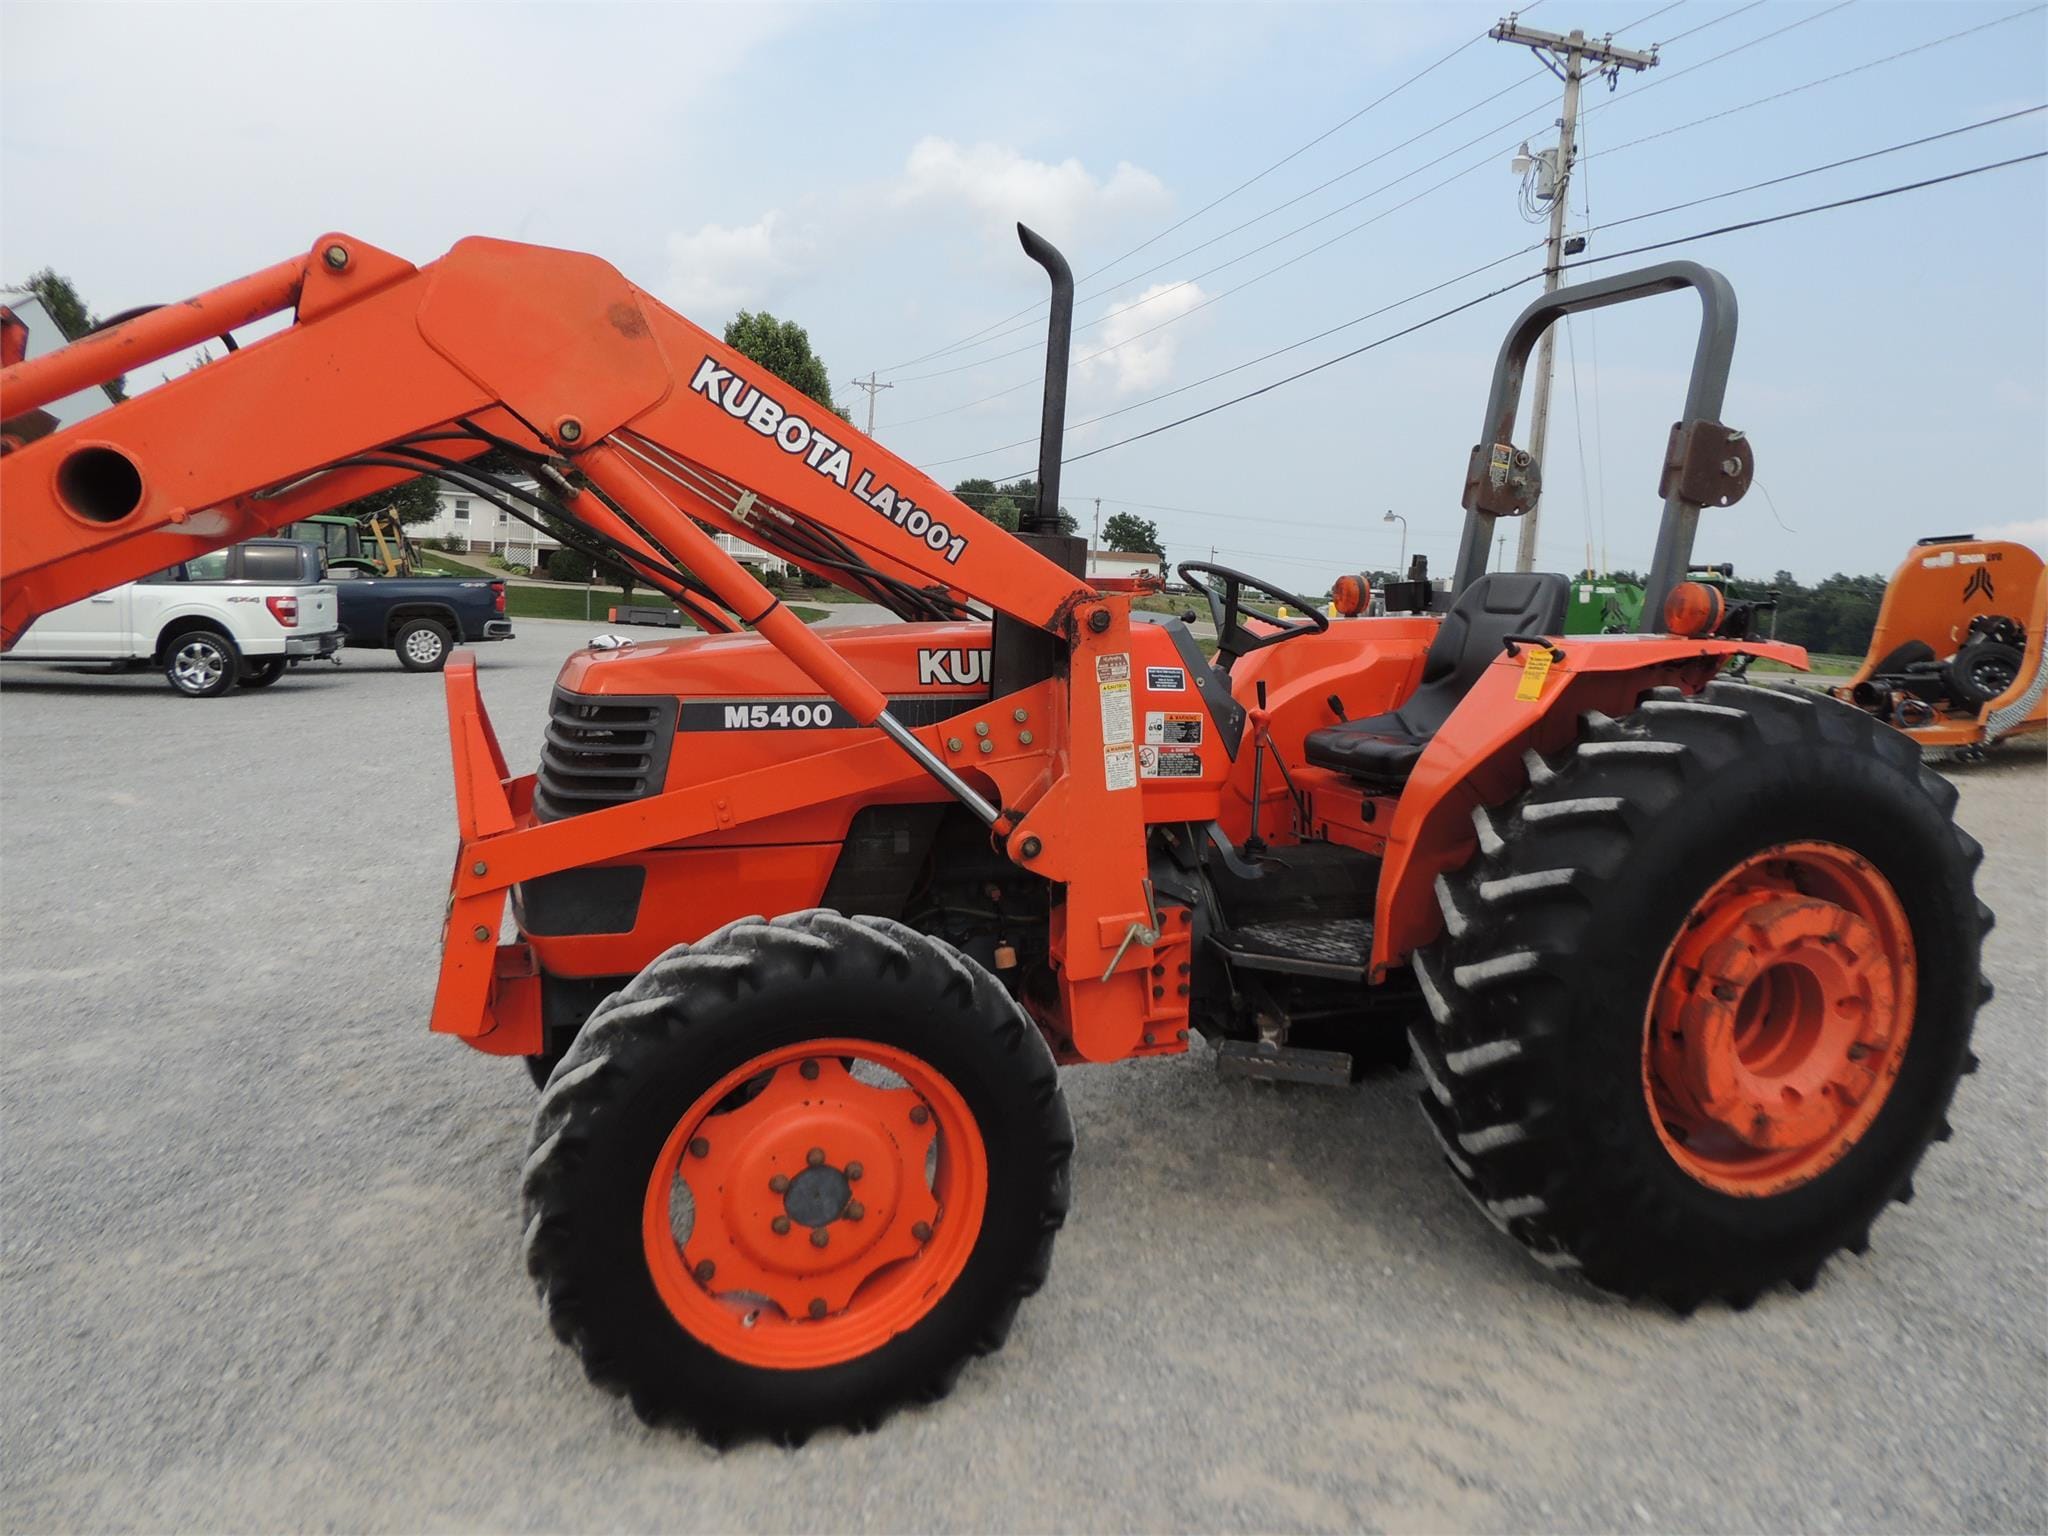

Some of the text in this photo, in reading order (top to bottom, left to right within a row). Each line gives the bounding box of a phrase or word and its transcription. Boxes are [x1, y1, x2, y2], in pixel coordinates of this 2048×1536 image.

[688, 354, 969, 566] KUBOTA LA1001
[723, 703, 833, 729] M5400
